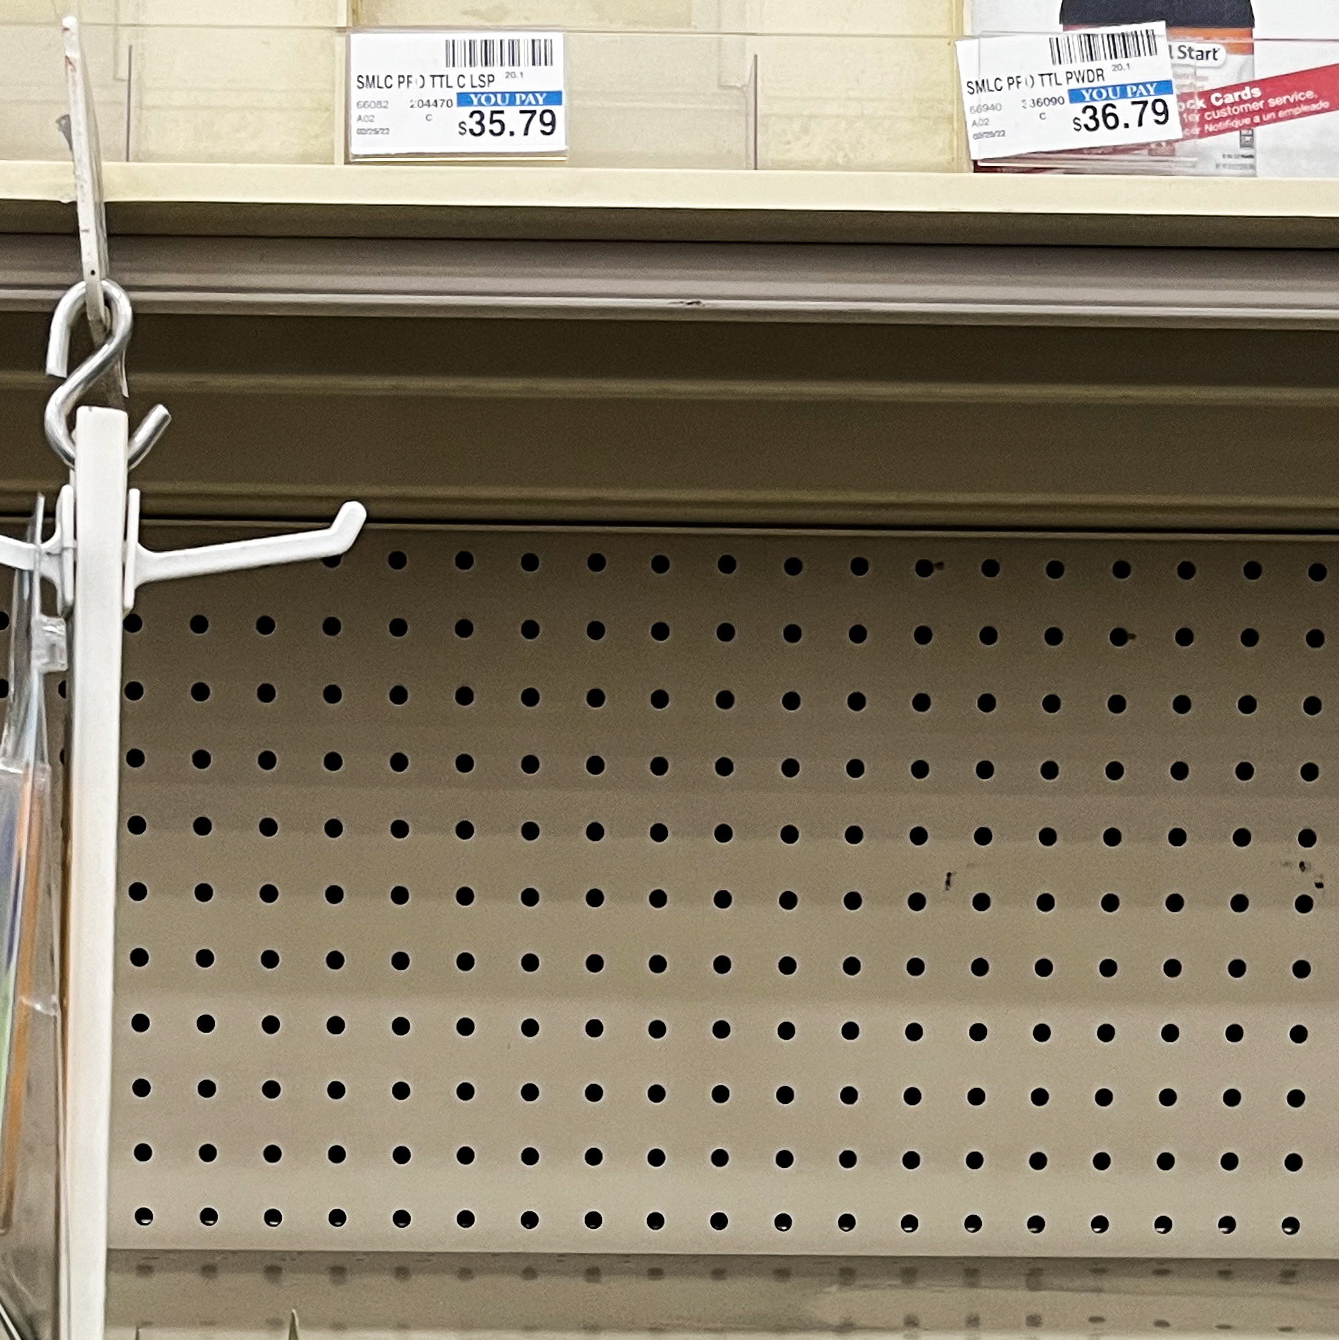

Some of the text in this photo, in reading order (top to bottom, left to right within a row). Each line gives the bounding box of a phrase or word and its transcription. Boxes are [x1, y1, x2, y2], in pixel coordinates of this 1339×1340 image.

[1177, 45, 1221, 62] Start
[356, 74, 495, 89] SMLC TTL LSP
[966, 69, 1105, 95] SMLC TTL PWDR
[469, 93, 547, 106] YOU PAY
[1081, 83, 1158, 101] YOU PAY
[1210, 86, 1262, 106] Cards
[1073, 98, 1170, 132] $36.79
[1204, 100, 1264, 121] customer
[458, 109, 556, 137] $35.79
